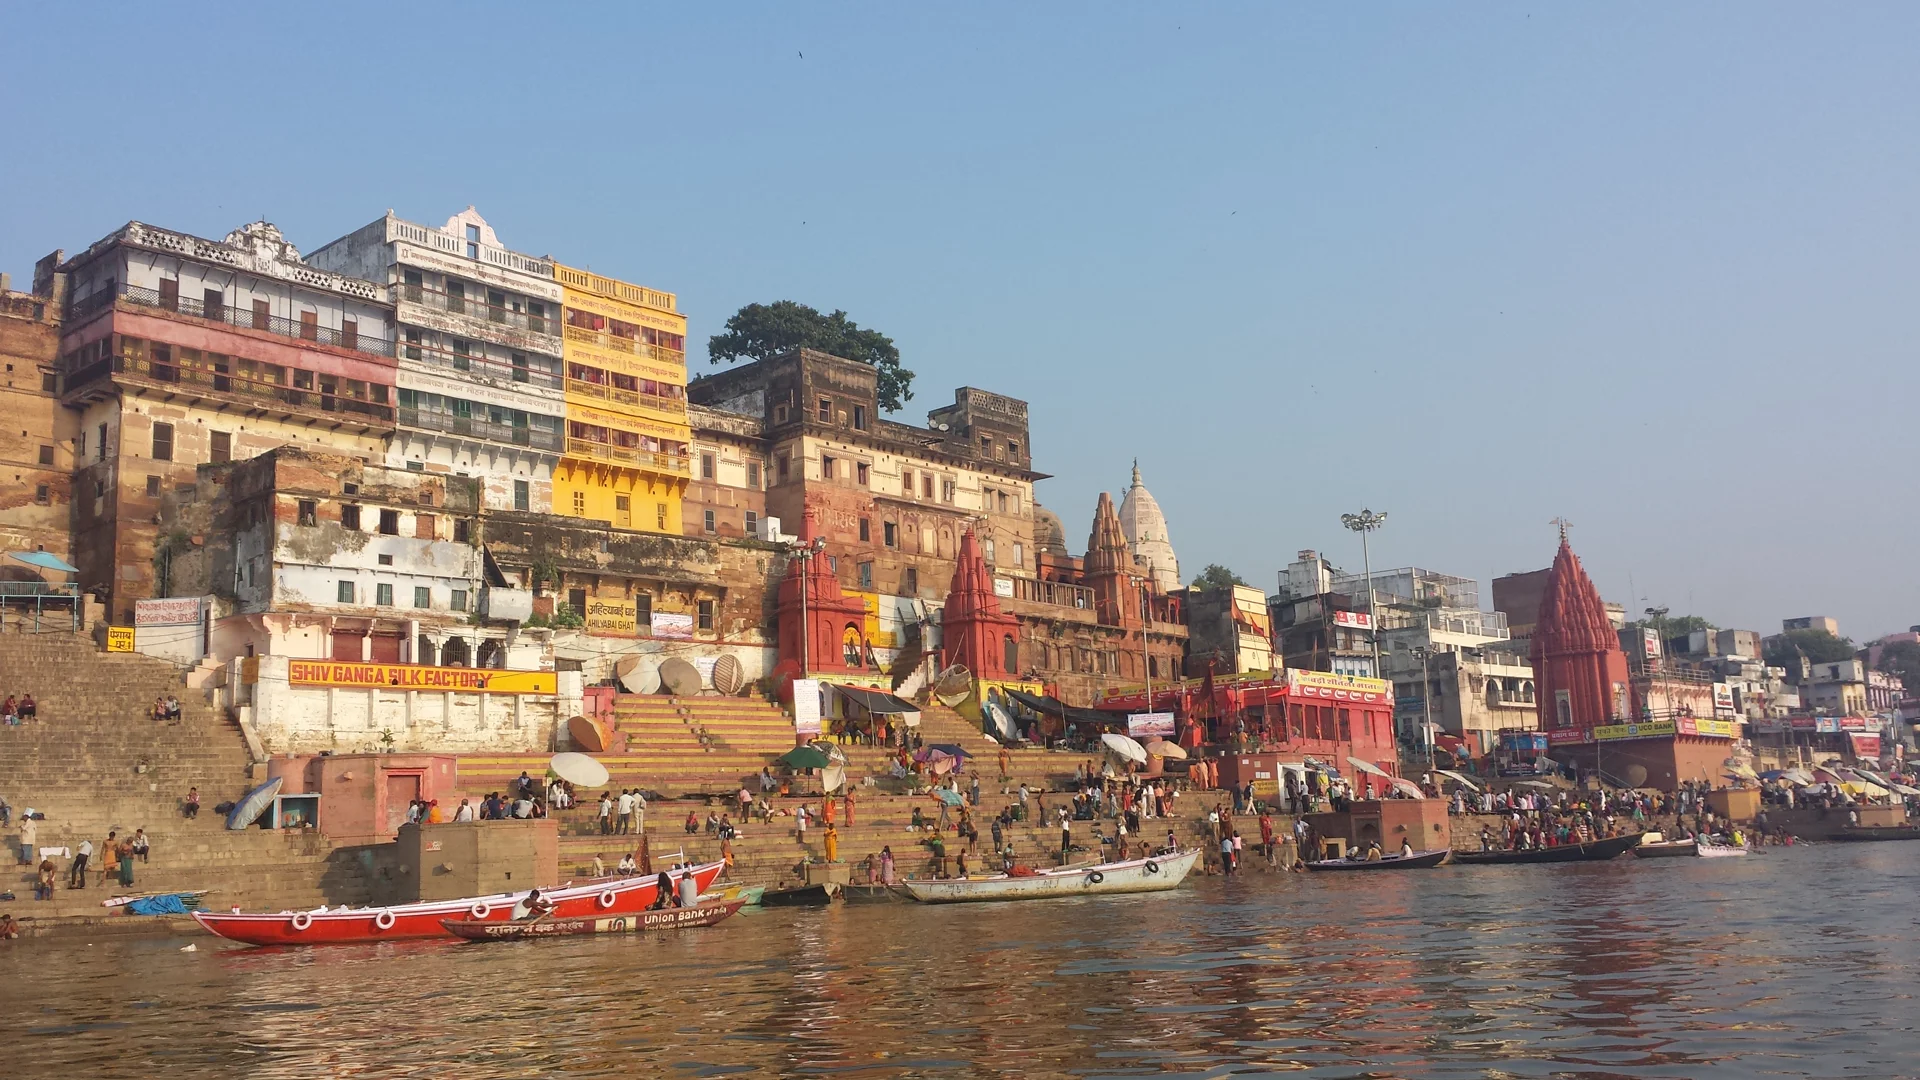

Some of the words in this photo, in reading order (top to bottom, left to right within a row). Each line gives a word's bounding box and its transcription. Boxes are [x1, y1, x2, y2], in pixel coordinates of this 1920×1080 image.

[587, 601, 624, 617] अहिल्याबाई
[625, 607, 635, 617] घाट
[587, 619, 617, 629] AHILYABAI
[618, 621, 635, 631] GHAT
[110, 628, 132, 640] पेशाब
[291, 664, 331, 682] SHIV
[333, 667, 385, 683] GANGA
[388, 669, 423, 686] SILK
[424, 670, 493, 689] FACTORY
[644, 914, 675, 924] Union
[678, 909, 705, 921] Bank
